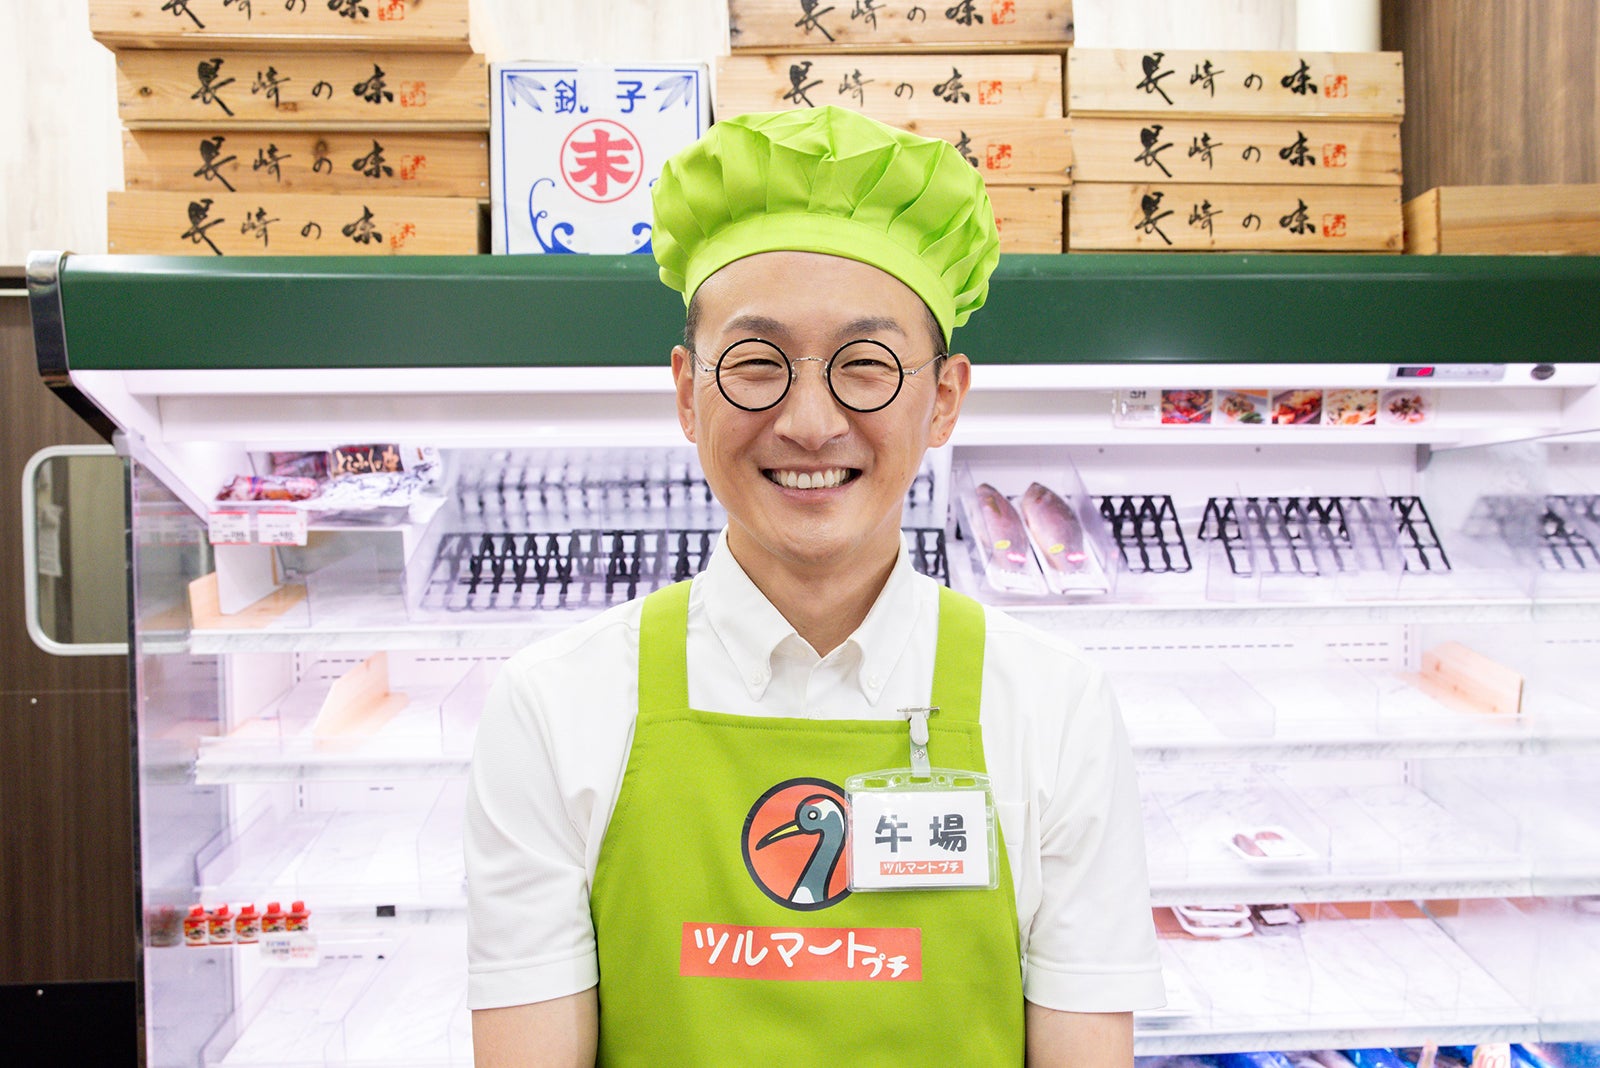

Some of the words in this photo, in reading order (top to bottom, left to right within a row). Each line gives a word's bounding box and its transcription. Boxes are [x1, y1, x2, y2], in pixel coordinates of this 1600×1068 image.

[191, 58, 394, 116] 長崎の味
[783, 61, 970, 108] 長崎の味
[1137, 52, 1318, 105] 長崎の味
[193, 135, 393, 192] 長崎の味
[1135, 124, 1316, 178] 長崎の味
[181, 198, 382, 255] 長崎の味
[1134, 191, 1316, 246] 長崎の味
[875, 814, 967, 852] 牛場
[883, 862, 960, 874] ツルマートプチ
